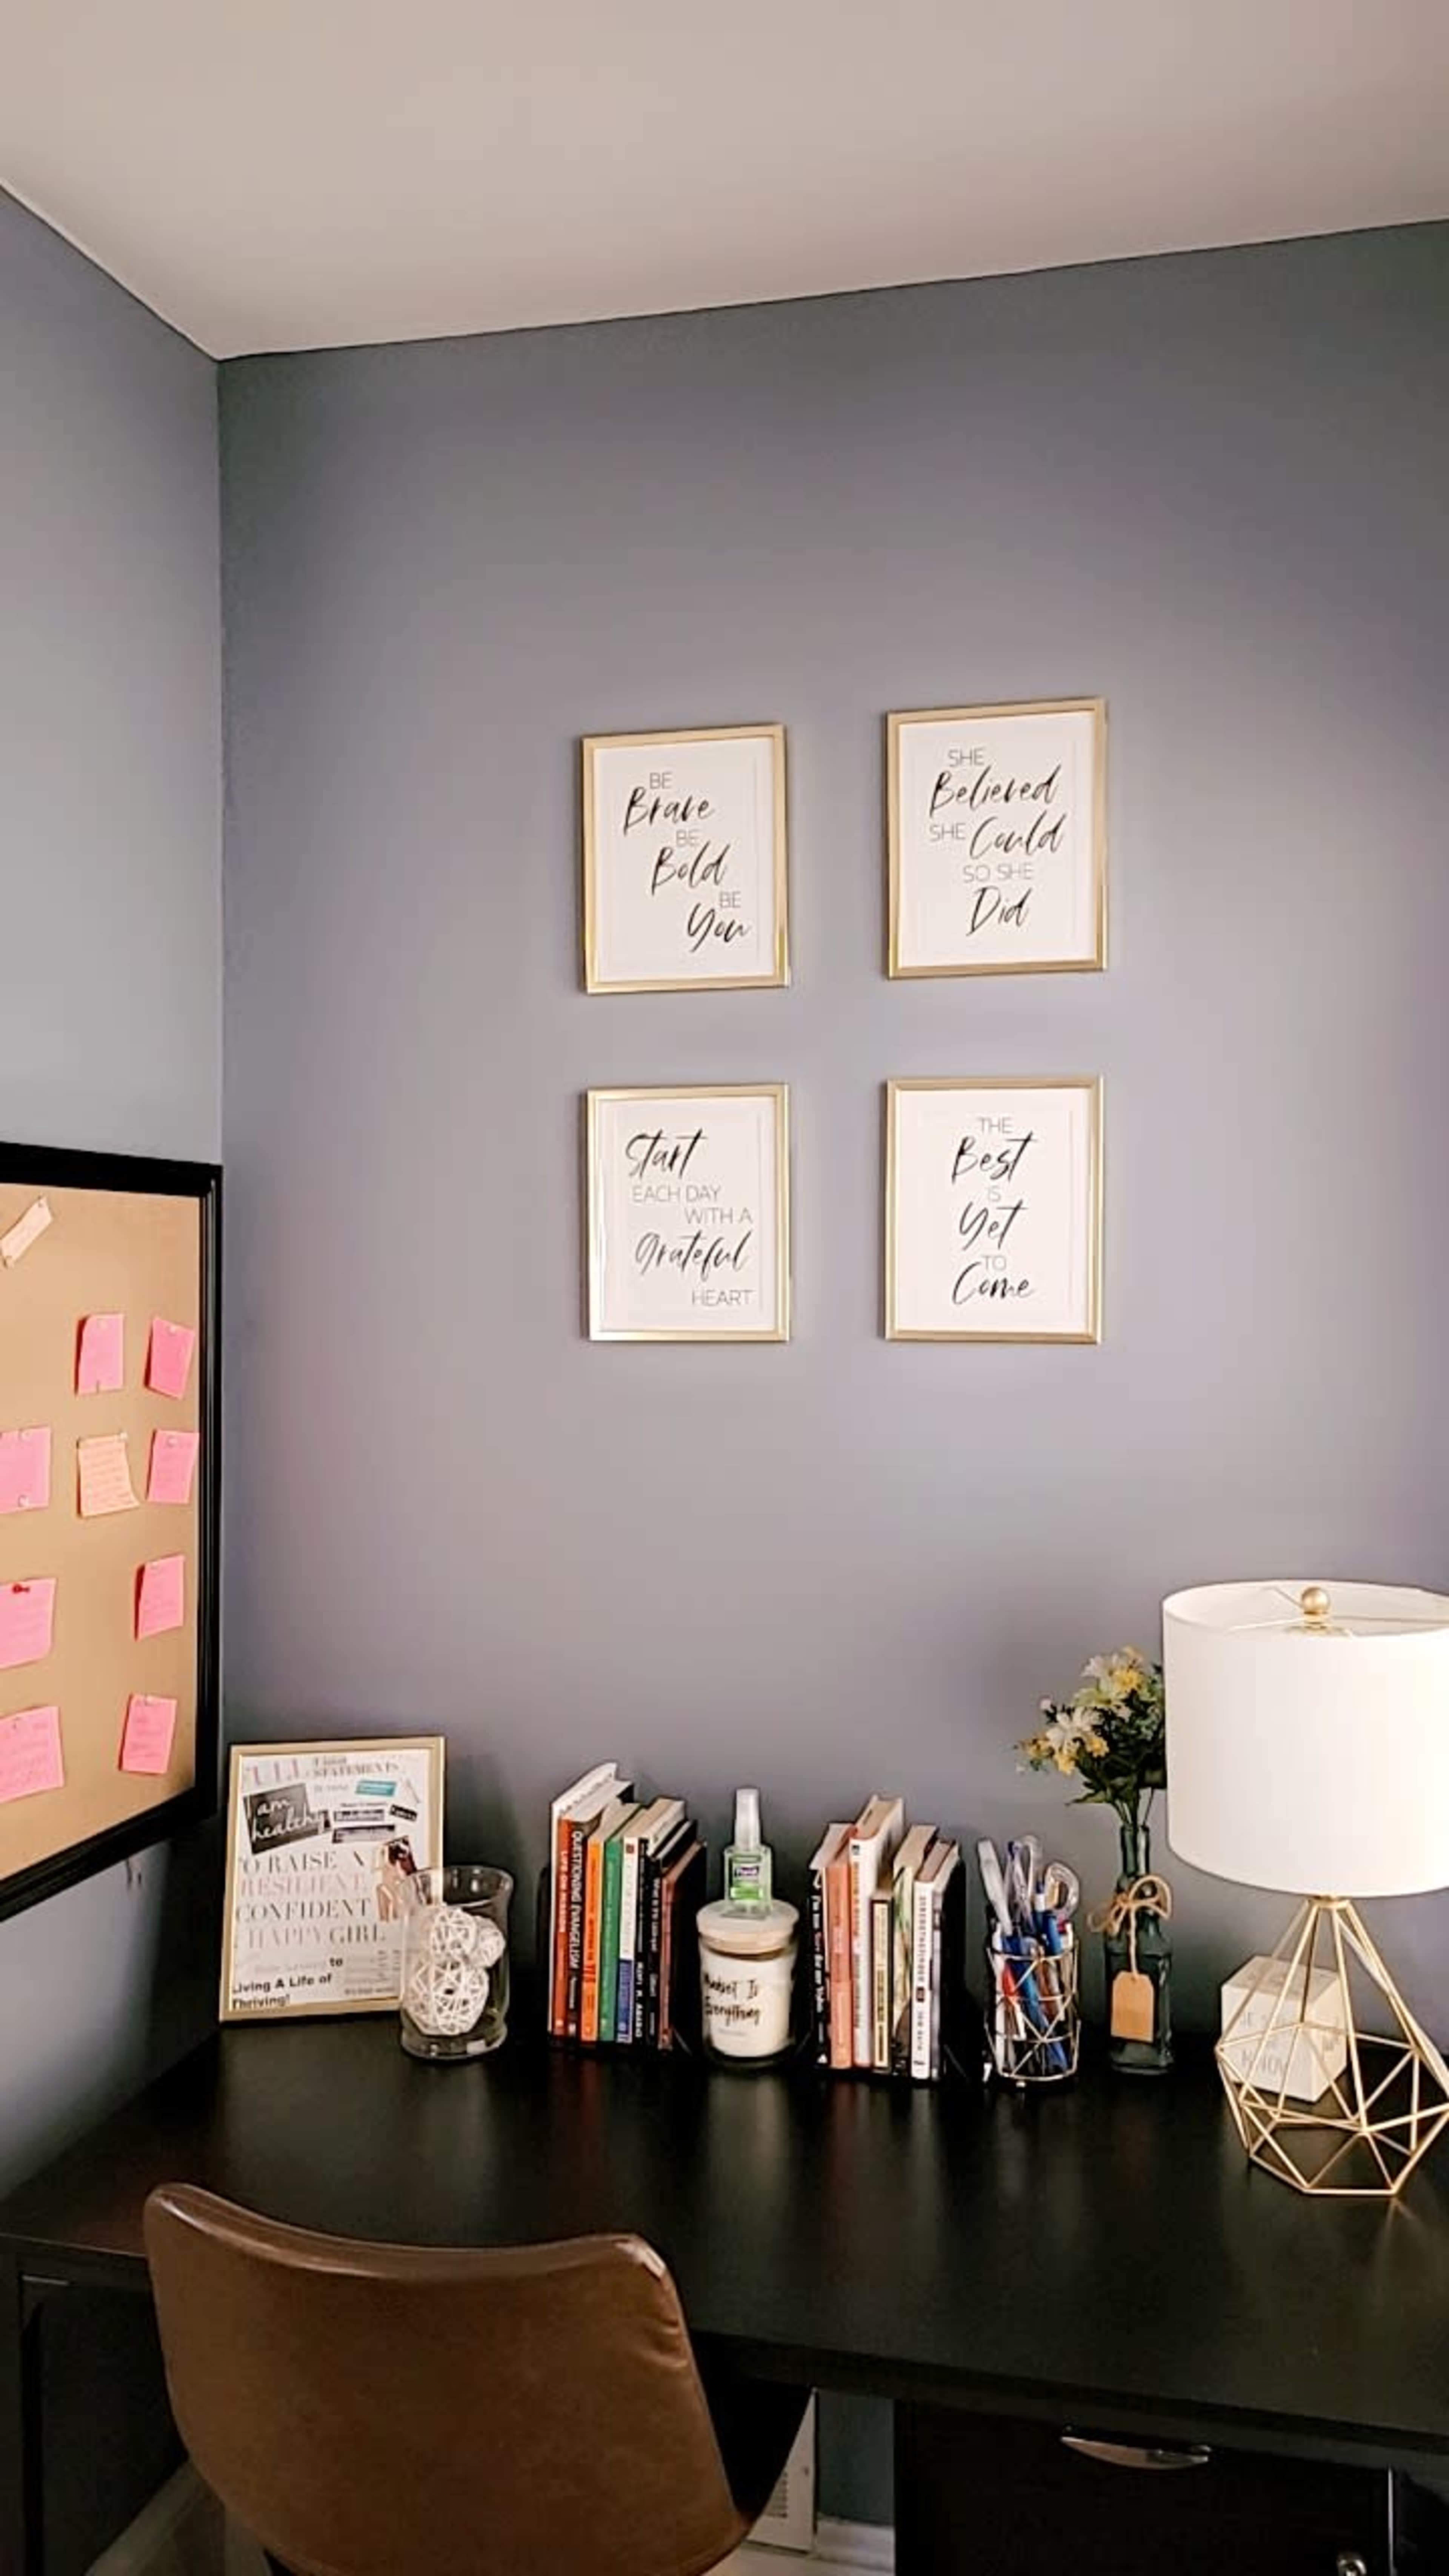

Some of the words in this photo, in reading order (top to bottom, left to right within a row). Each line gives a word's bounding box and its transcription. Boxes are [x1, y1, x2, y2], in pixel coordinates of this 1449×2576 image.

[948, 747, 986, 767] SHE
[649, 772, 672, 790] BE
[929, 764, 1062, 818] Believed
[623, 786, 716, 836] Brave
[675, 829, 699, 847] BE
[929, 823, 966, 842] SHE
[970, 812, 1068, 860] Could
[651, 840, 730, 896] Bold
[963, 865, 991, 883] SO
[997, 863, 1034, 881] SHE
[719, 891, 741, 909] BE
[966, 885, 1033, 937] Did
[687, 902, 751, 953] You
[978, 1116, 1014, 1134] THE
[625, 1127, 709, 1179] Start
[951, 1130, 1038, 1185] Best
[632, 1184, 680, 1203] EACH
[686, 1184, 721, 1203] DAY
[987, 1186, 1002, 1203] IS
[684, 1207, 734, 1224] WITH
[739, 1207, 752, 1224] A
[959, 1199, 1029, 1251] Yet
[980, 1254, 1007, 1271] TO
[952, 1261, 1035, 1305] Come
[692, 1289, 754, 1307] HEART
[239, 1855, 260, 1873] O
[268, 1850, 338, 1874] RAISE
[571, 1831, 582, 1902] QUESTIONING
[235, 1898, 371, 1922] CONFIDENT
[569, 1904, 582, 1969] EVANGELISM
[329, 1957, 343, 1967] to
[276, 1977, 284, 1988] A
[289, 1976, 314, 1987] Life
[319, 1973, 332, 1984] of
